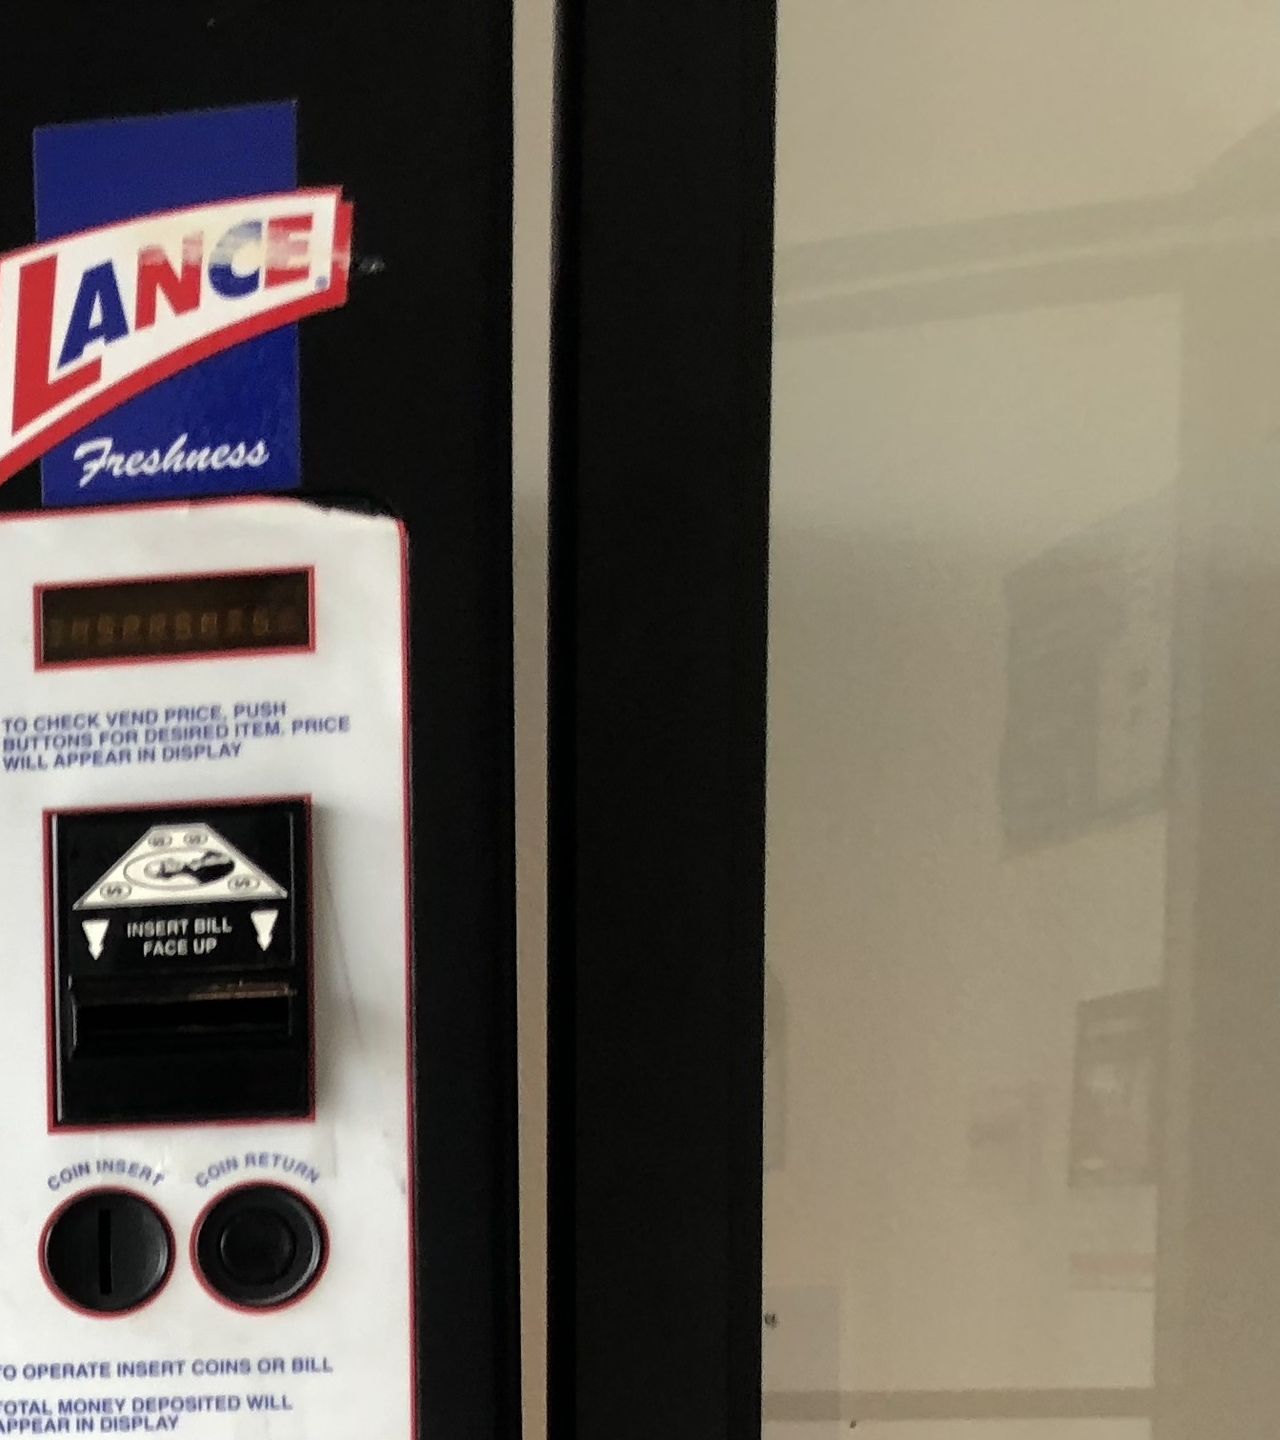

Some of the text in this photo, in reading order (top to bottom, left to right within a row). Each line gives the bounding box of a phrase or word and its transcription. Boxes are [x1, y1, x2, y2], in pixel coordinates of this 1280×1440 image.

[11, 211, 315, 437] LANCE
[73, 433, 270, 488] Freshness
[2, 717, 27, 735] TO
[34, 712, 99, 733] CHECK
[107, 709, 158, 727] VEND
[234, 701, 286, 719] PUSH
[3, 733, 92, 752] BUTTONS
[100, 729, 137, 746] FOR
[145, 724, 229, 744] DESIRED
[292, 715, 350, 734] PRICE
[3, 742, 242, 772] WILL APPEAR IN DISPLAY
[127, 917, 232, 938] INSERT BILL
[143, 937, 217, 957] FACE UP
[47, 1158, 165, 1191] COIN INSERT
[195, 1151, 320, 1188] COIN RETURN
[23, 1362, 111, 1380] OPERATE
[117, 1360, 186, 1377] INSERT
[192, 1358, 251, 1376] COINS
[258, 1357, 285, 1375] OR
[292, 1356, 333, 1374] BILL
[58, 1398, 125, 1414] MONEY
[132, 1395, 240, 1413] DEPOSITED
[246, 1394, 293, 1411] WILL
[76, 1417, 94, 1433] IN
[100, 1415, 179, 1432] DISPLAY
